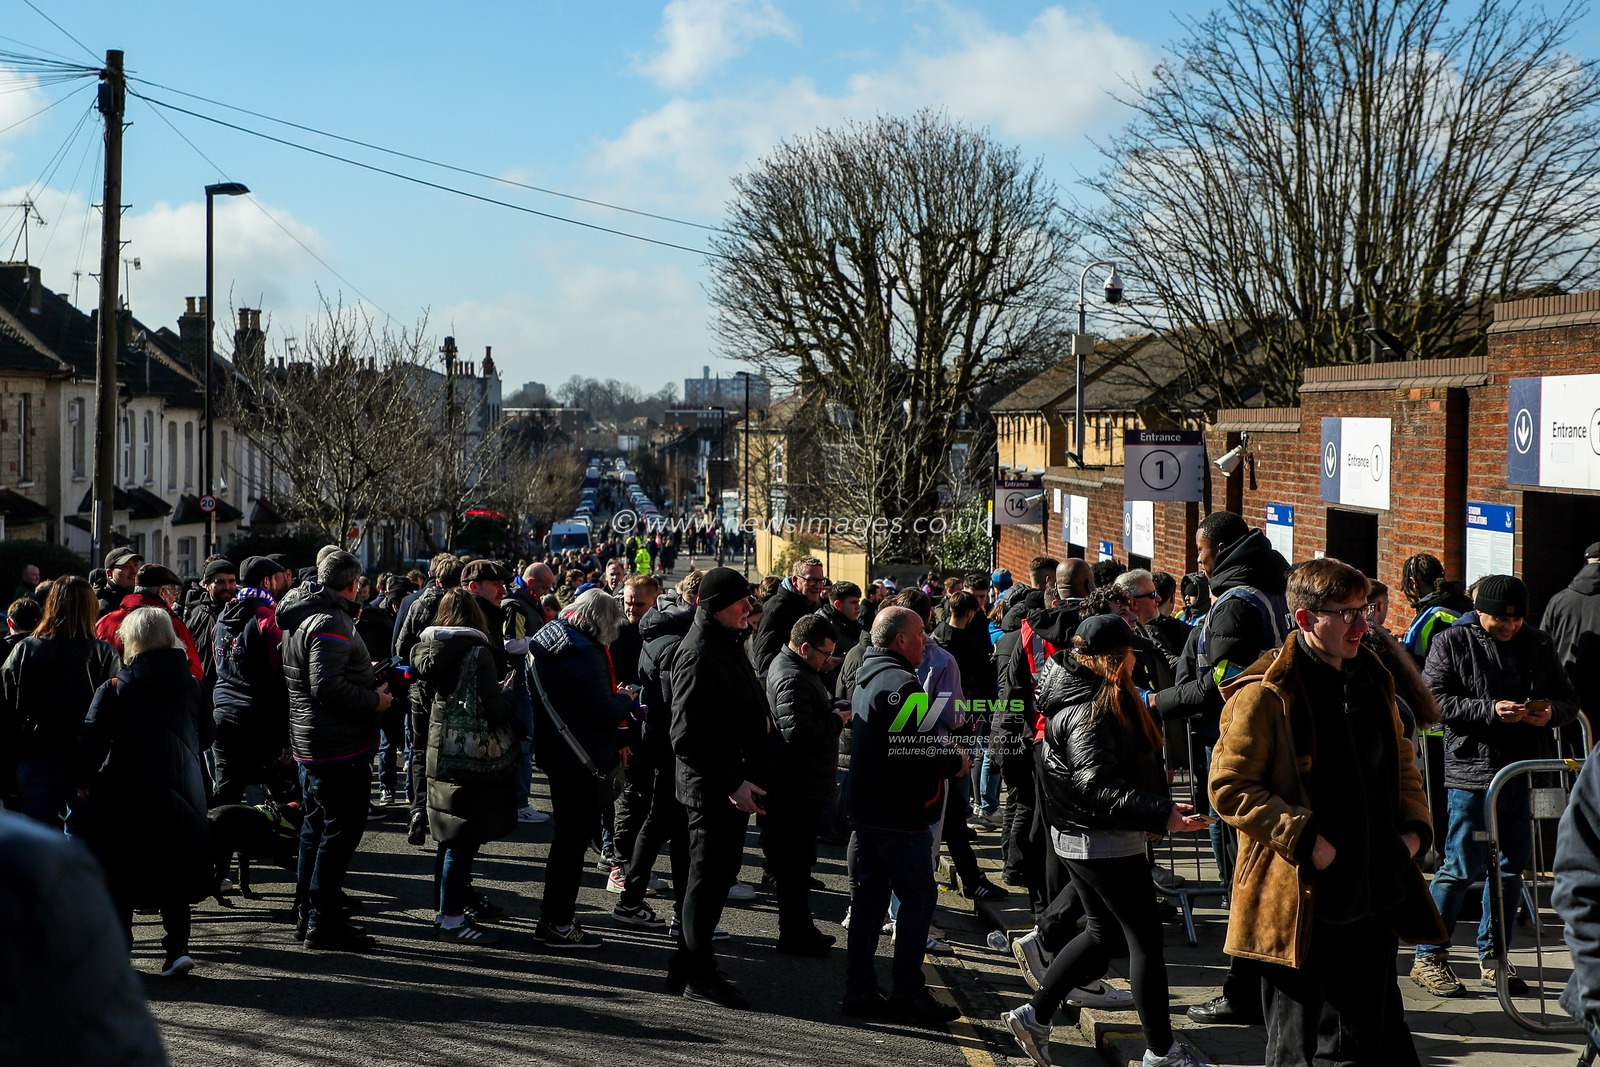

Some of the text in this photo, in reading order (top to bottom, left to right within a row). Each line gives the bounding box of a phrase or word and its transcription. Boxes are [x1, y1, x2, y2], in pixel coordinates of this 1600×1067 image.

[1140, 432, 1181, 442] Entrance
[1552, 421, 1587, 439] Entrance
[1347, 453, 1370, 468] Entrance
[1155, 460, 1164, 480] 1
[201, 499, 215, 508] 20
[1008, 498, 1025, 511] 14
